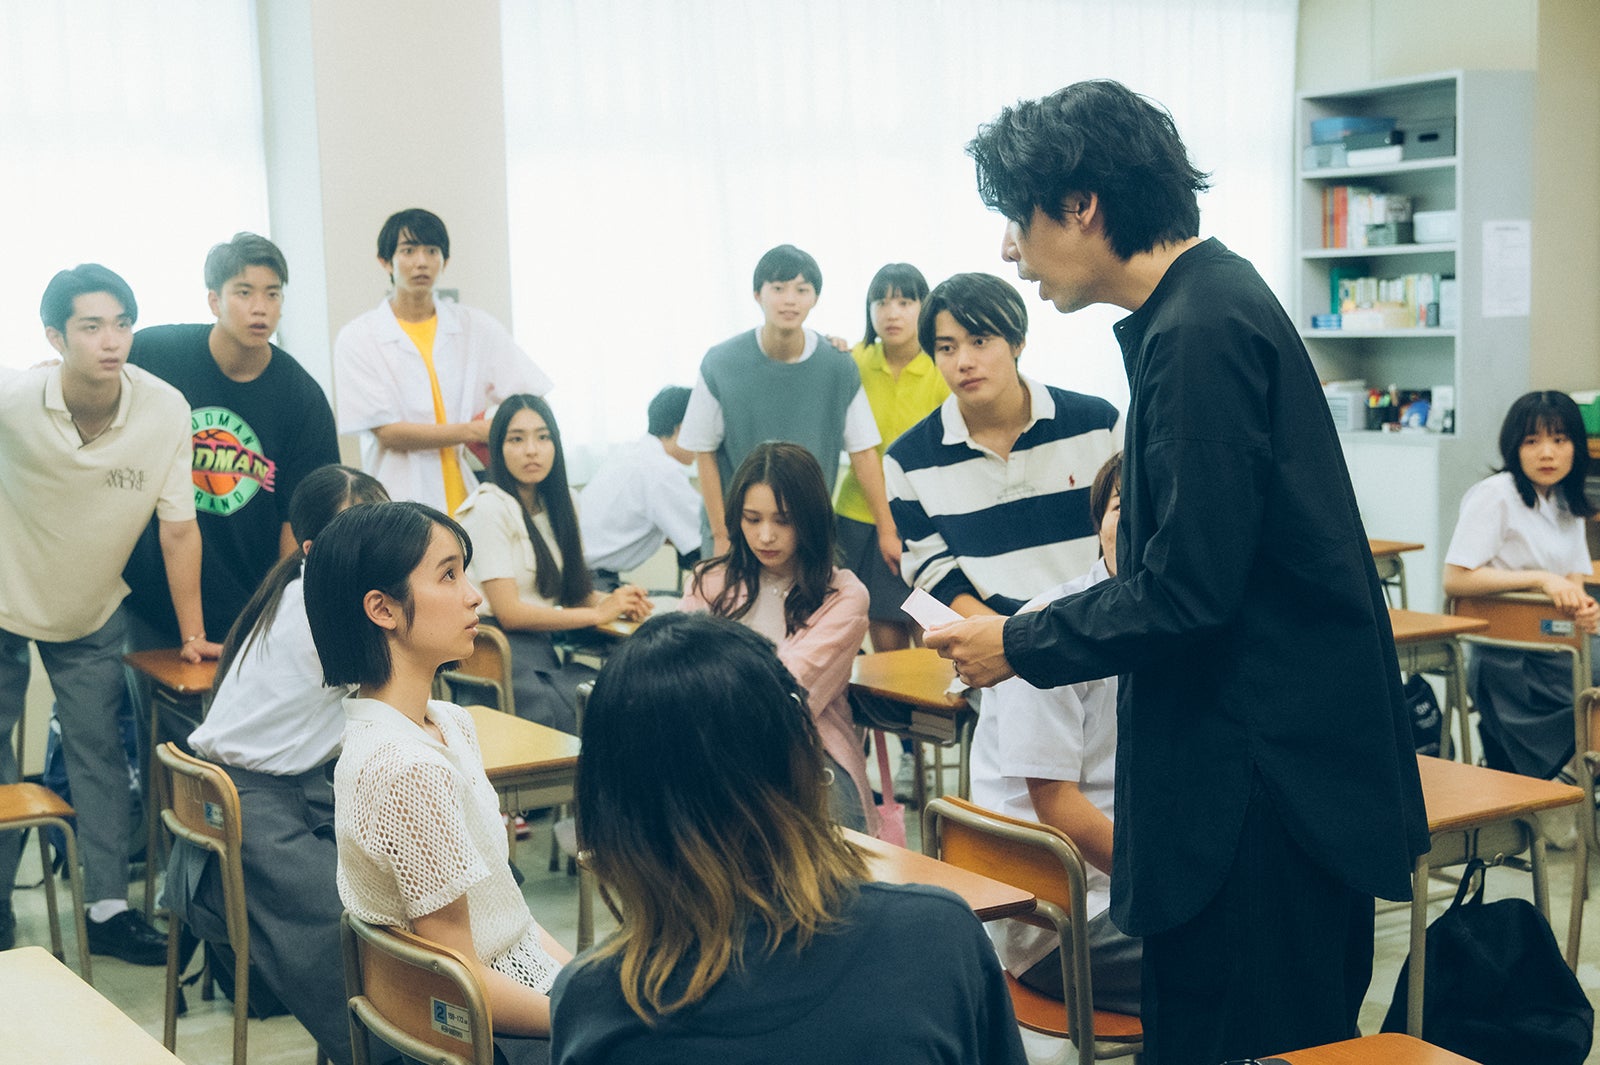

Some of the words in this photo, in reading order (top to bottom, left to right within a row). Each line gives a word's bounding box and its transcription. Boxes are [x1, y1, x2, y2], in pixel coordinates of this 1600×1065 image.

[192, 412, 254, 446] ODMAN
[192, 443, 269, 480] DMAN
[194, 491, 244, 512] RAND
[436, 1006, 444, 1020] 2
